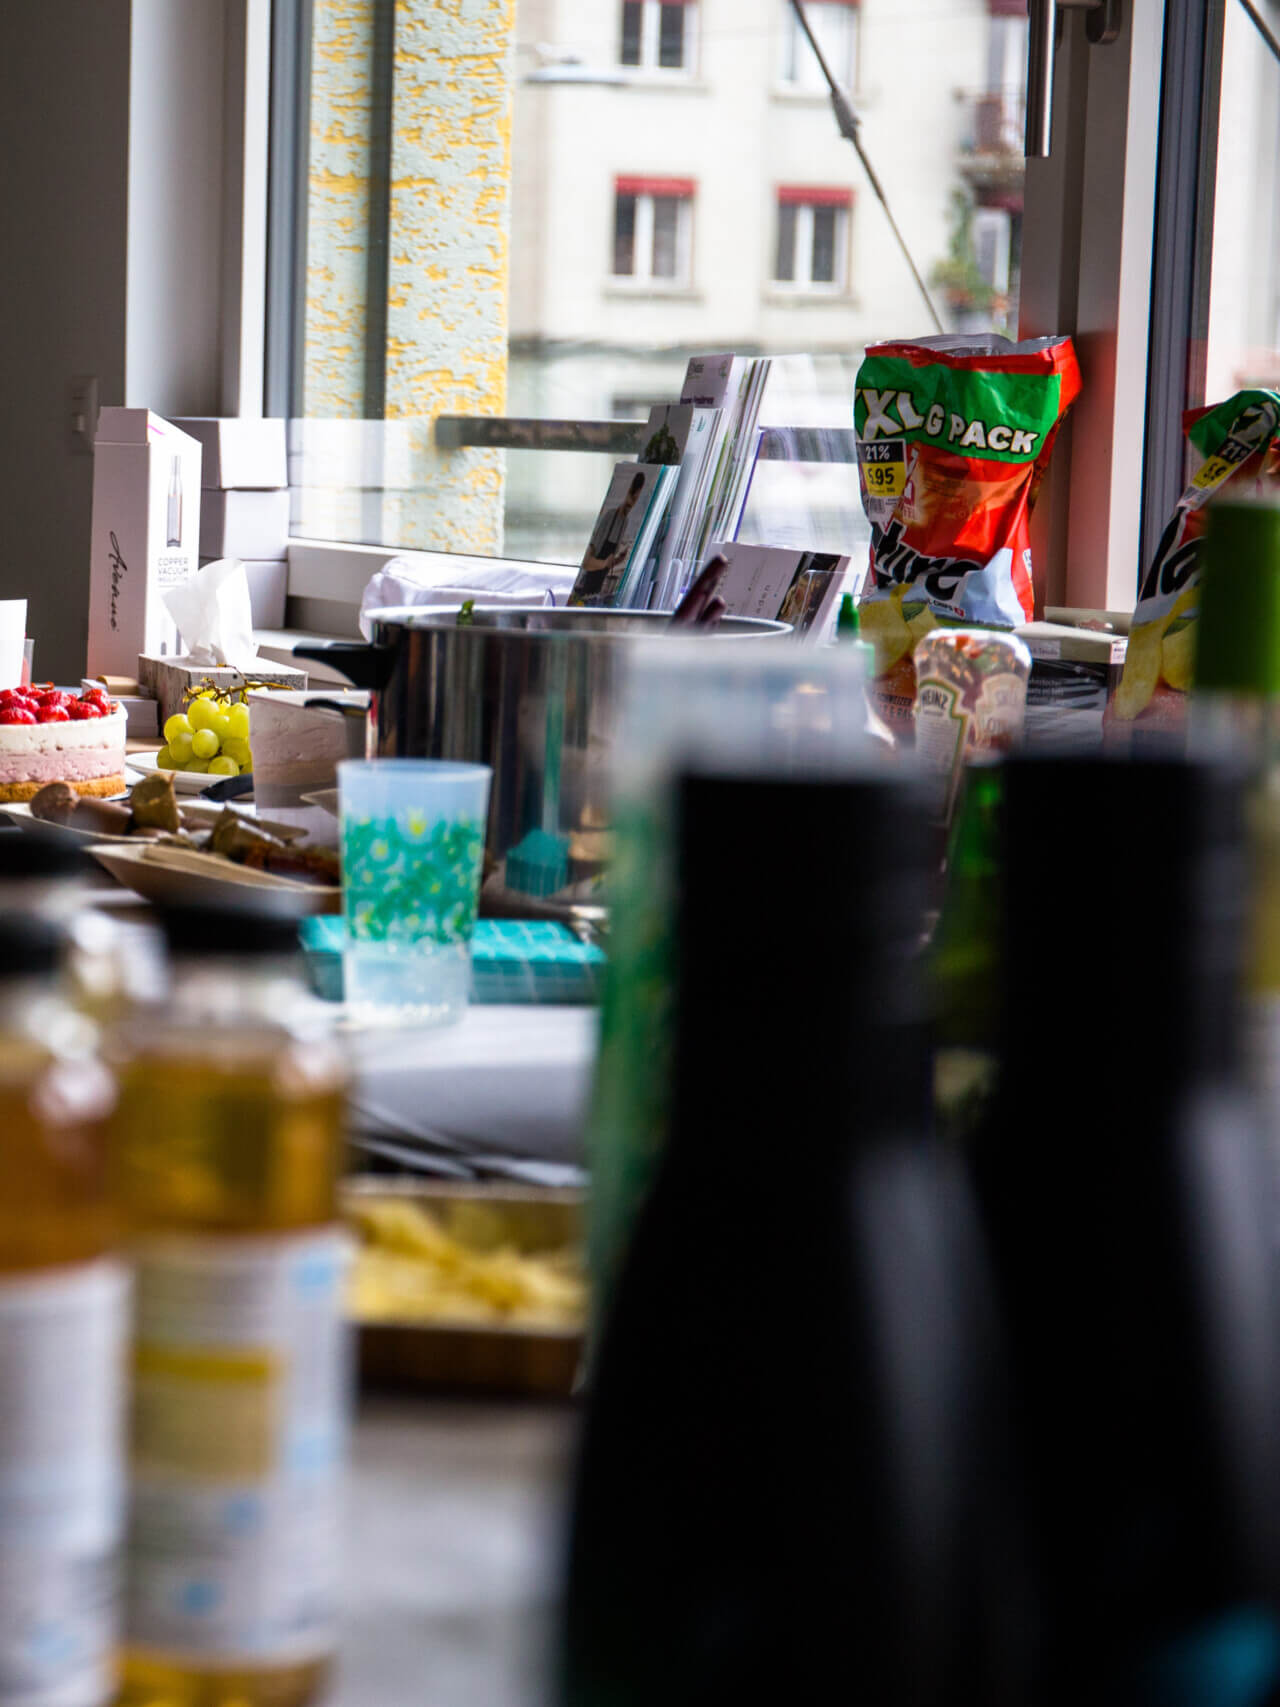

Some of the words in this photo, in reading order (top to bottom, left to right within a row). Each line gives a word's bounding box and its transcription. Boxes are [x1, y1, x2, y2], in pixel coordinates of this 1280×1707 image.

[856, 388, 924, 440] XL
[948, 411, 1040, 454] PACK
[865, 445, 891, 460] 21%
[921, 689, 949, 710] HEINZ
